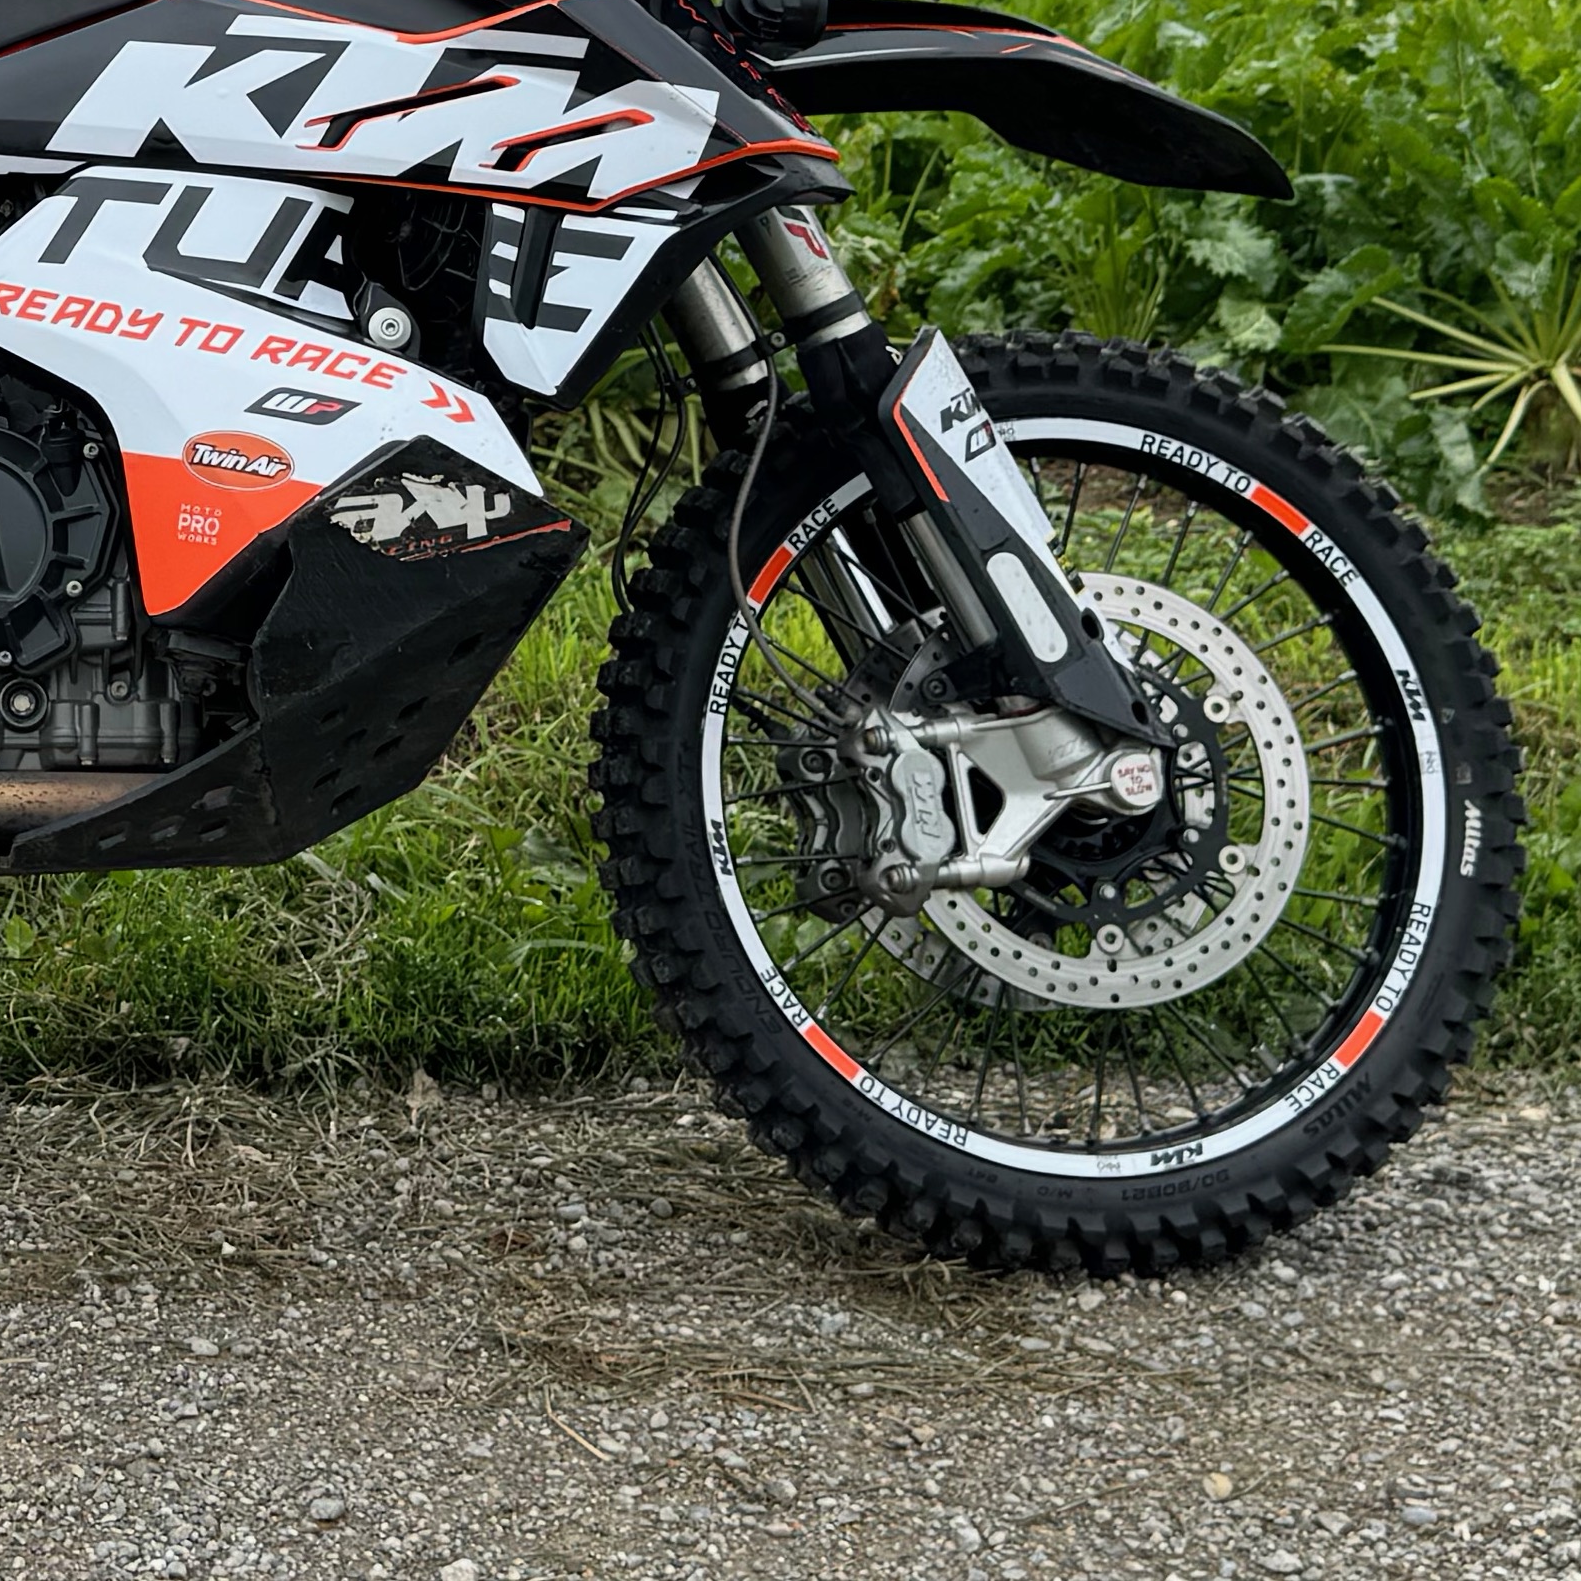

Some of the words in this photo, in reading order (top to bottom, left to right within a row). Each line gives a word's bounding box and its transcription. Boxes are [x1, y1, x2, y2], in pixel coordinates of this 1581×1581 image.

[45, 13, 719, 201] KTM
[177, 316, 245, 355] TO
[249, 336, 409, 391] RACE
[261, 392, 345, 415] WP
[192, 442, 248, 472] Twin
[246, 455, 289, 479] Air
[177, 513, 220, 536] PRO
[180, 503, 223, 518] MOTO
[1140, 433, 1221, 478] READY
[1219, 465, 1252, 494] TO
[1303, 529, 1361, 588] RACE
[176, 532, 218, 547] WORKS
[709, 637, 743, 717] READY
[787, 498, 840, 551] RACE
[1395, 668, 1427, 722] KTM
[710, 818, 733, 877] KTM
[1459, 798, 1482, 877] Mitas
[1390, 901, 1433, 983] READY
[759, 964, 810, 1028] RACE
[1374, 984, 1403, 1013] TO
[858, 1074, 885, 1106] TO
[1283, 1061, 1341, 1113] RACE
[889, 1098, 970, 1148] READY
[1149, 1141, 1204, 1167] KTM
